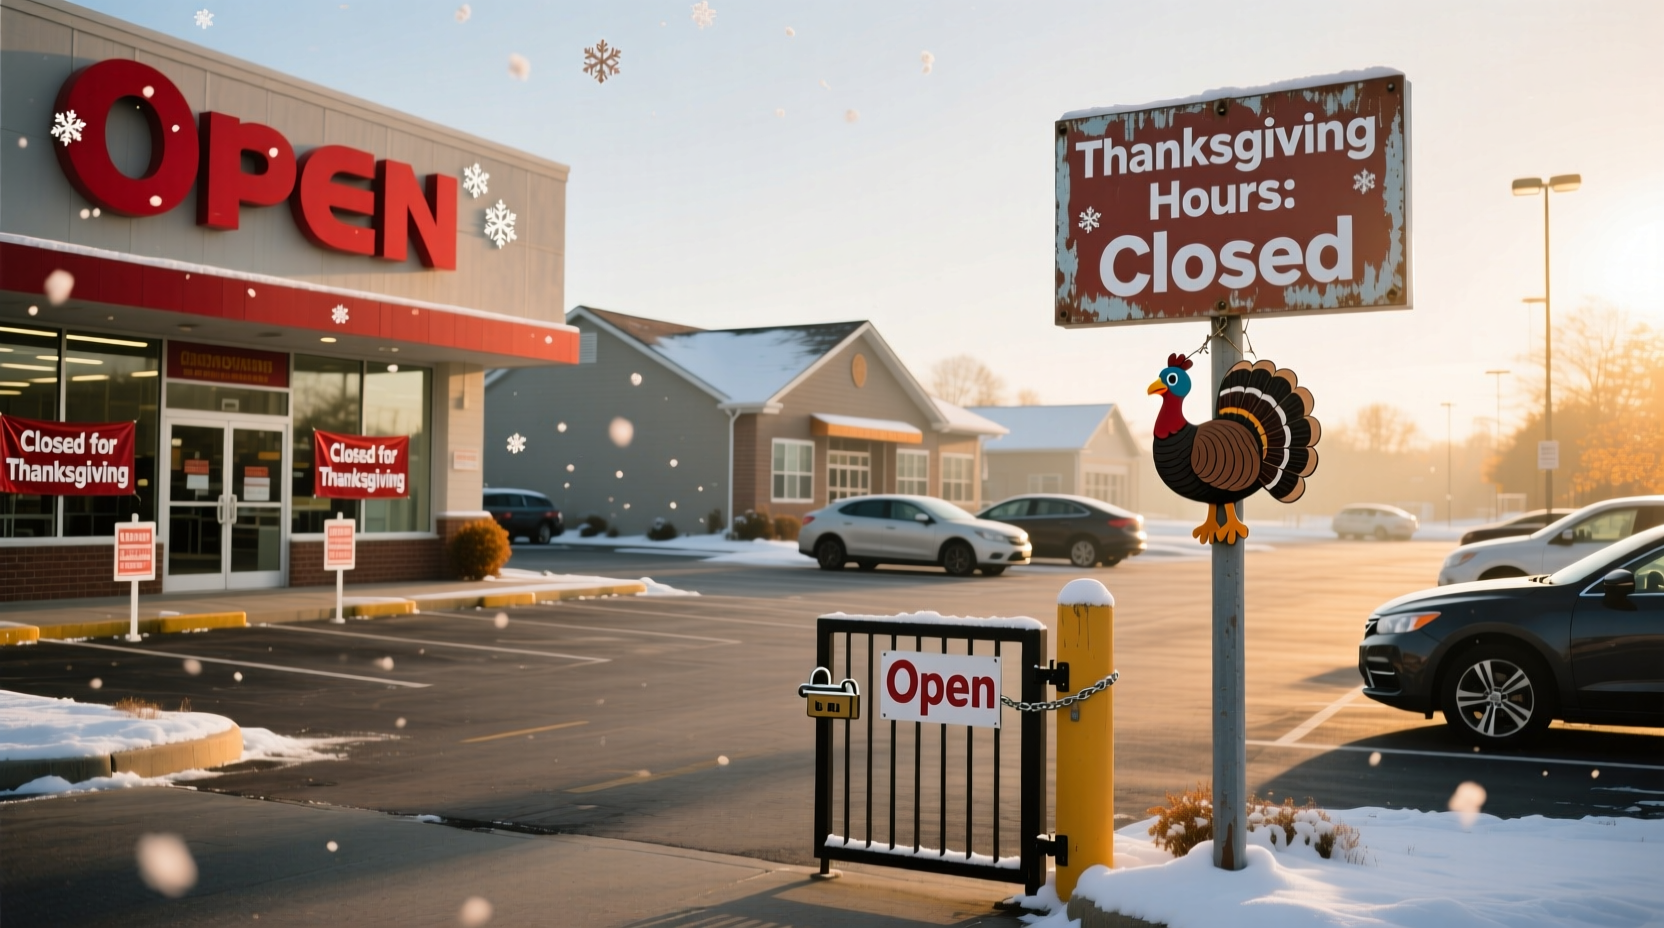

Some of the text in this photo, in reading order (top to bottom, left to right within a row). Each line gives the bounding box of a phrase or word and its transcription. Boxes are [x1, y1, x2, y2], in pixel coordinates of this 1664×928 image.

[53, 58, 457, 271] OPEN
[1075, 112, 1376, 179] Thanksgiving
[1150, 178, 1296, 220] Hours:
[1099, 215, 1353, 297] Closed
[20, 429, 118, 455] Closed for
[330, 442, 398, 464] Closed for
[6, 457, 129, 489] Thanksgiving
[319, 466, 405, 494] Thanksgiving
[886, 659, 996, 716] Open
